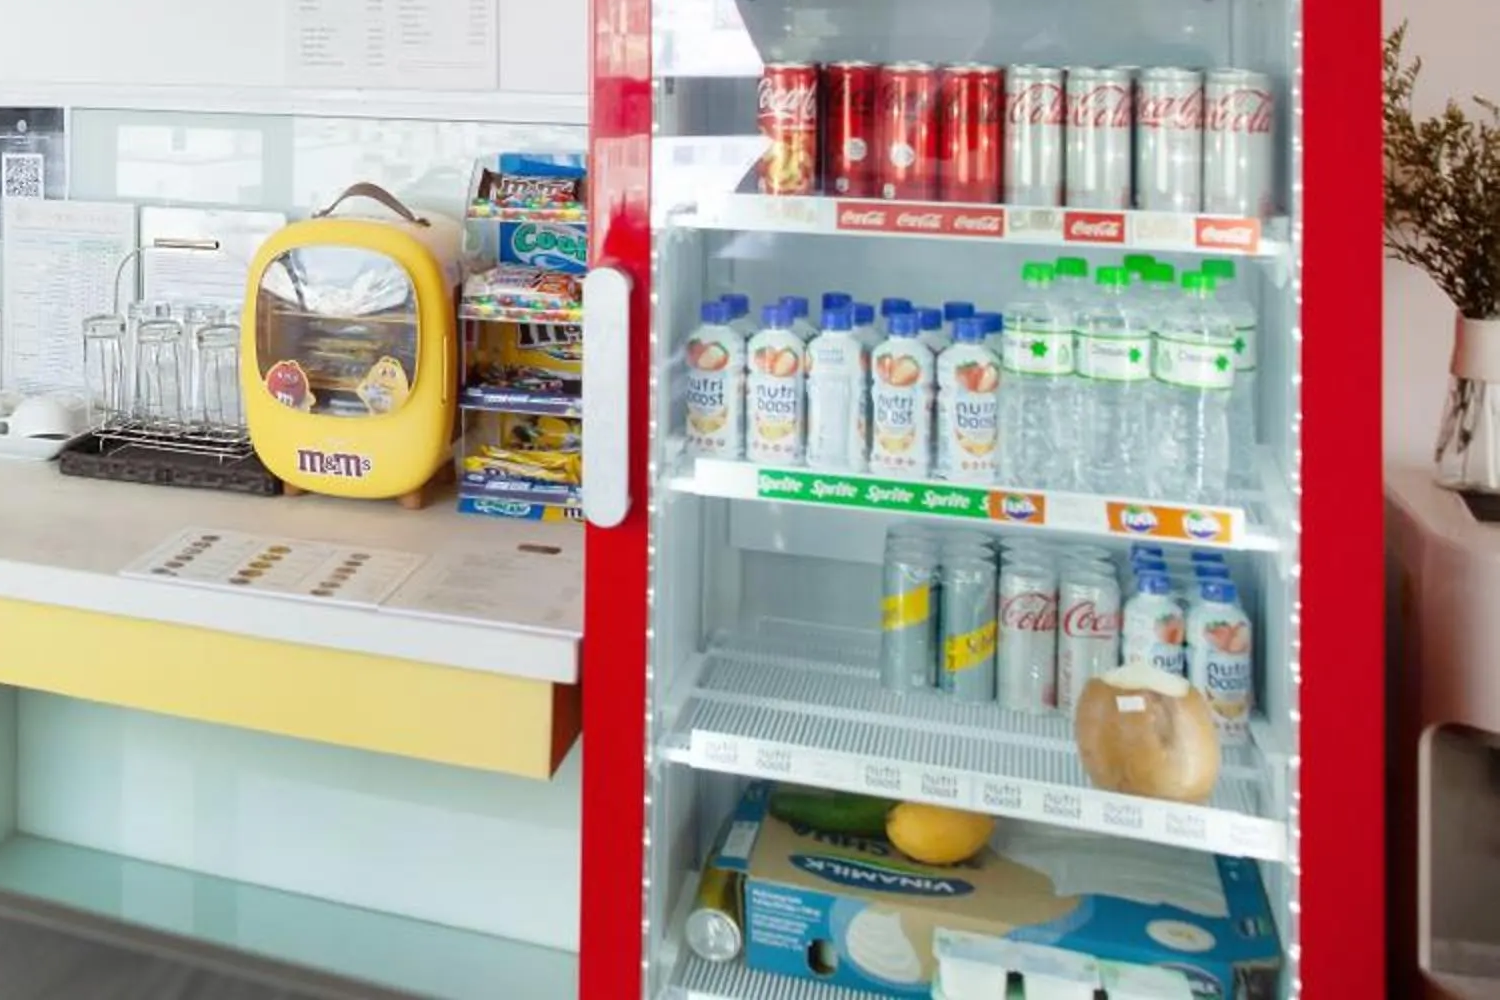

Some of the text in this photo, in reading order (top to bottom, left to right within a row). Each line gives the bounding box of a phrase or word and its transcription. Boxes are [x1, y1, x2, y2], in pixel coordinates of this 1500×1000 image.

[760, 474, 803, 493] Sprite
[809, 479, 859, 498] Sprite
[865, 484, 914, 503] Sprite
[921, 489, 971, 509] Sprite
[804, 857, 955, 894] VINAMILK
